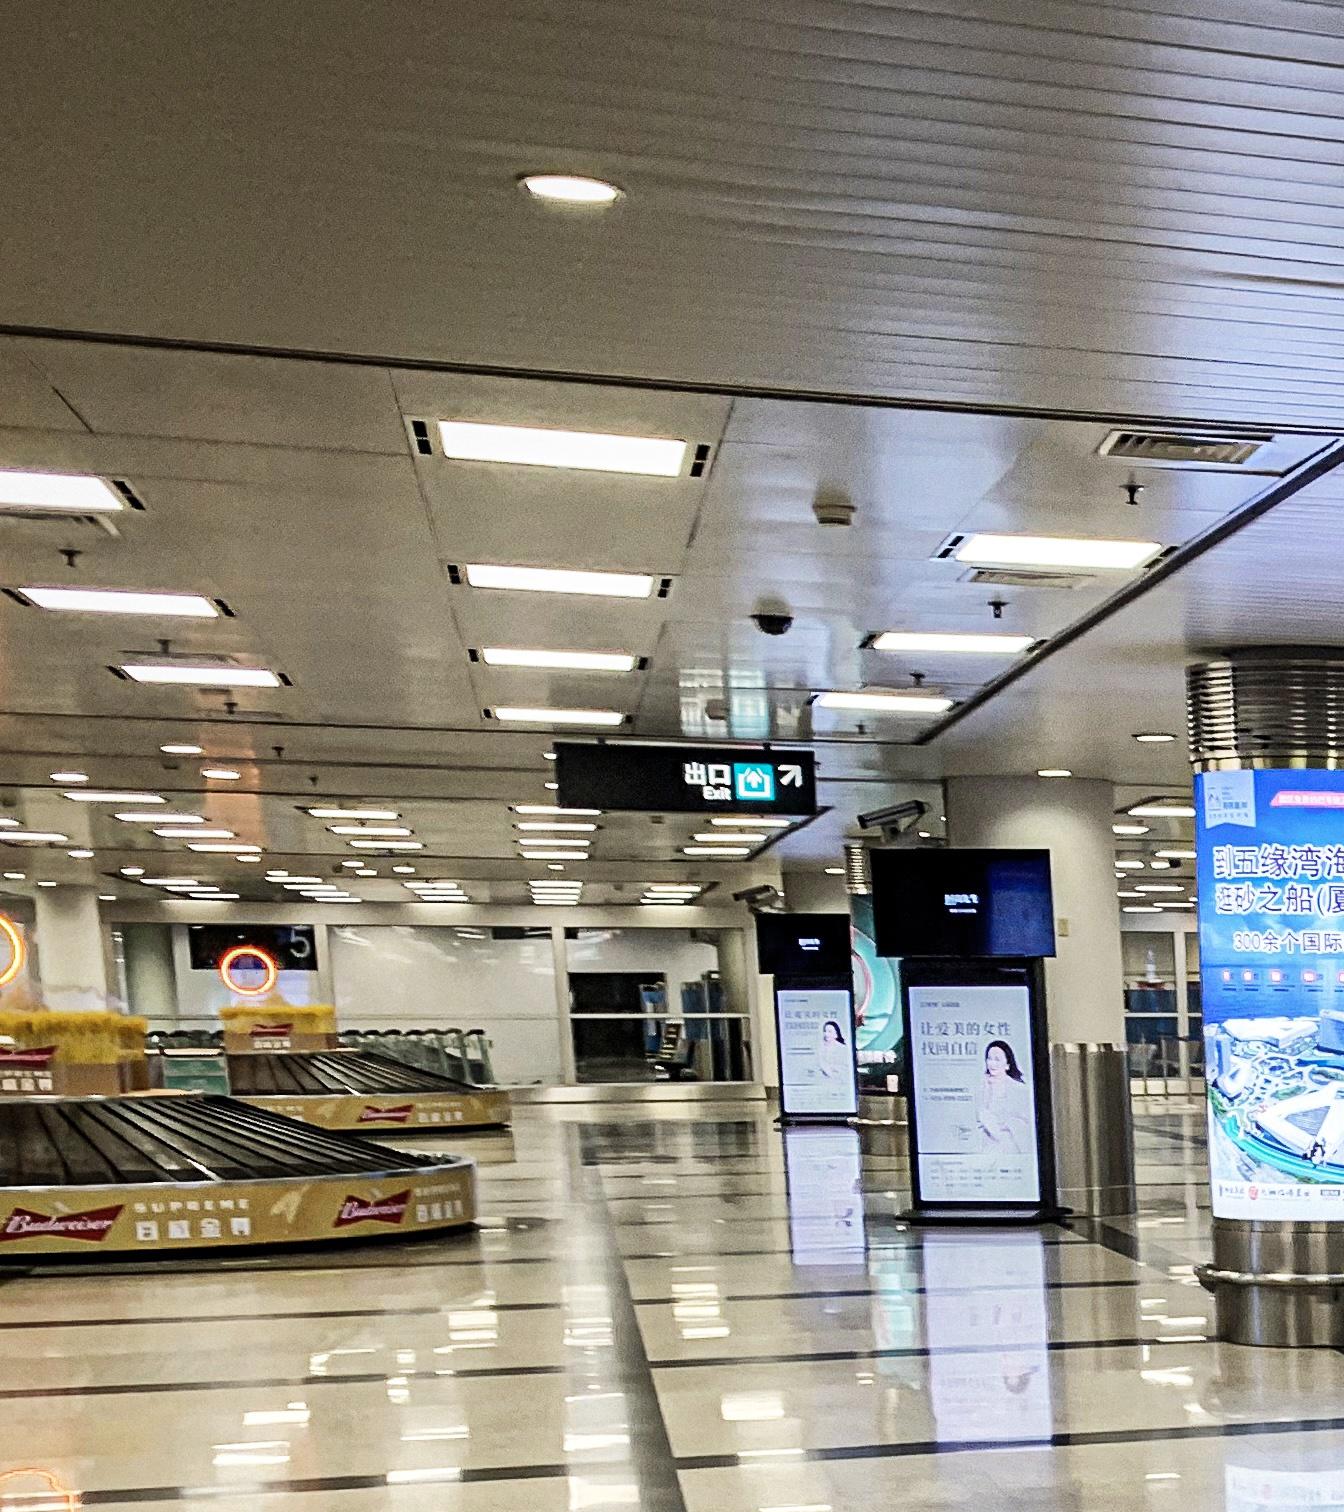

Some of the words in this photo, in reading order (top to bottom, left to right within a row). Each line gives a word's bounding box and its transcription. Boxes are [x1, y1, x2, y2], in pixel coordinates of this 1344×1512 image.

[684, 762, 732, 786] 出口
[702, 786, 732, 800] Exit
[290, 932, 311, 957] 5
